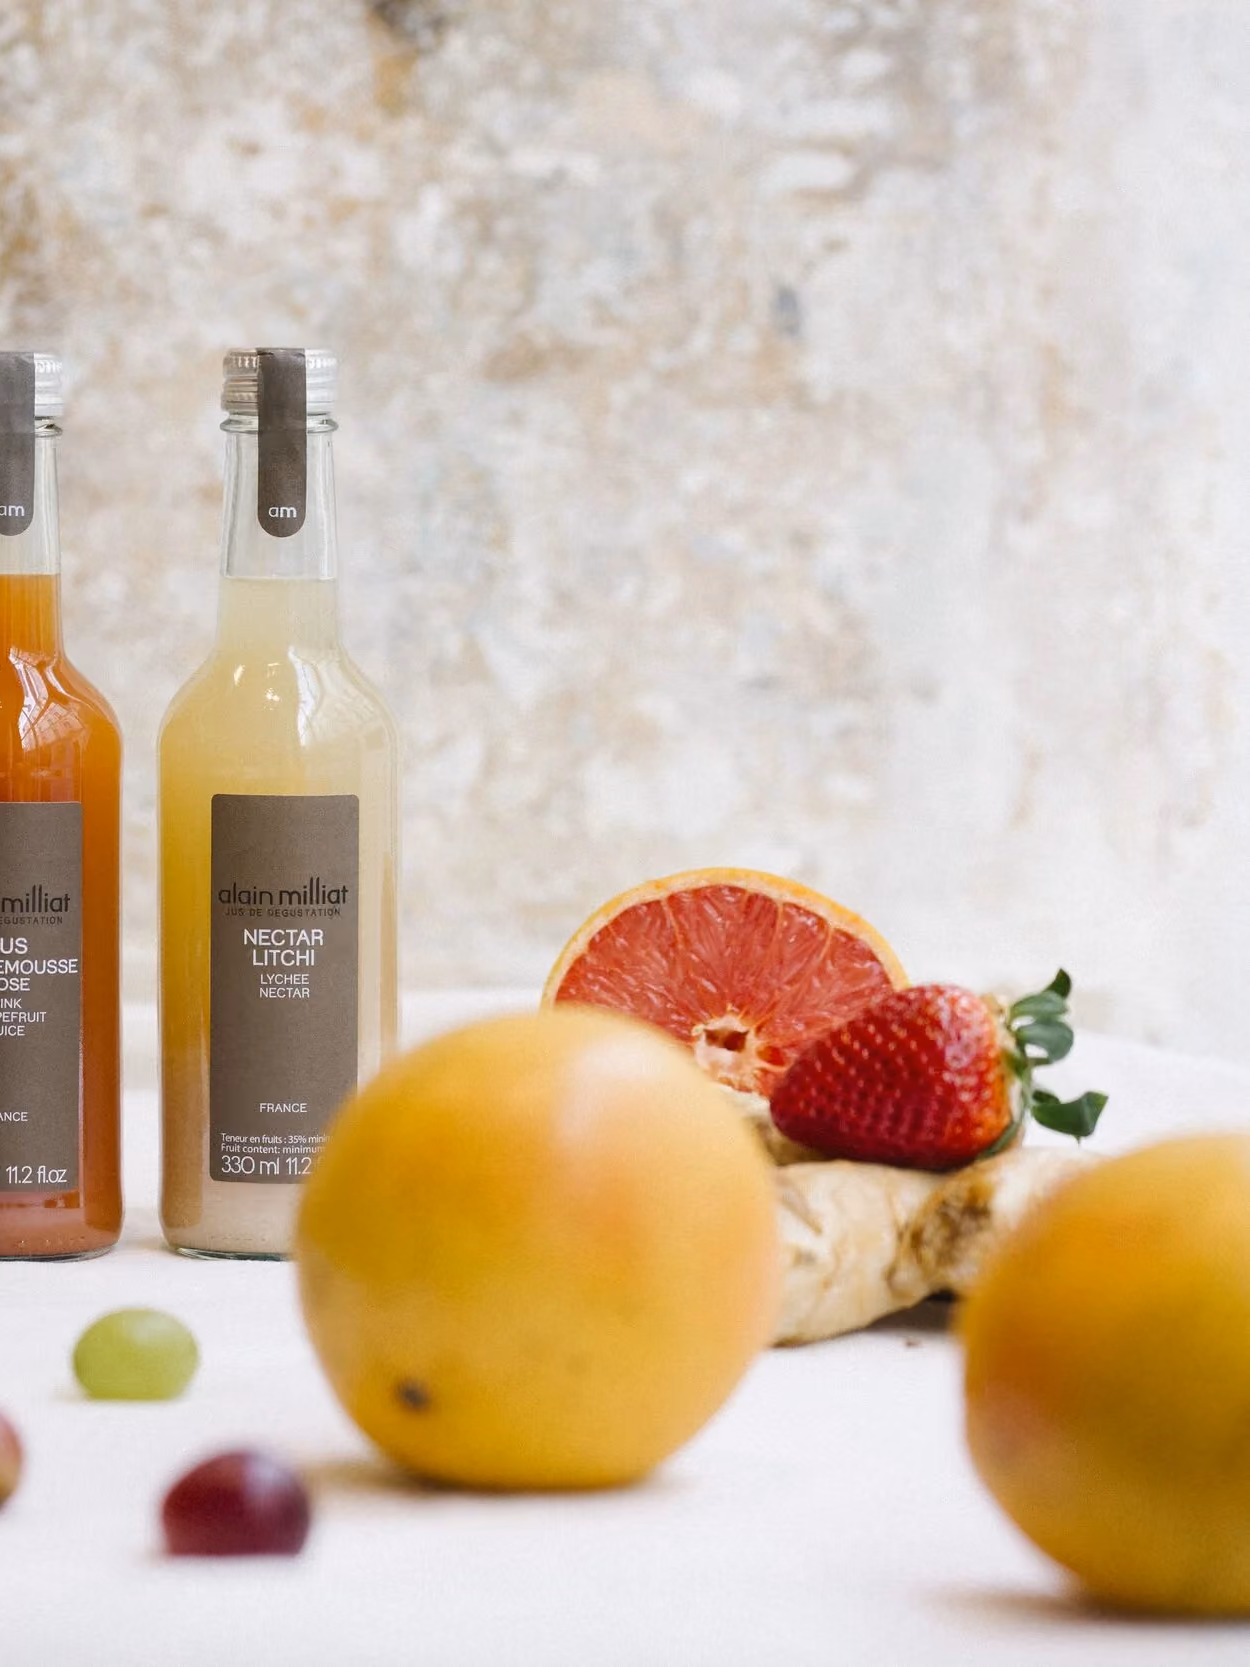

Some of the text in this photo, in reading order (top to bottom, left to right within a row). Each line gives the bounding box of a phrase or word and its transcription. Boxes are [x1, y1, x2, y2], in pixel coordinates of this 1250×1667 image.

[268, 506, 297, 518] am
[218, 877, 349, 905] alain milliat
[1, 884, 71, 913] milliat
[225, 907, 341, 918] JUS DE DEGUSTATION
[243, 928, 324, 946] NECTAR
[252, 949, 315, 966] LITCHI
[260, 973, 310, 985] LYCHEE
[259, 987, 310, 998] NECTAR
[259, 1103, 308, 1113] FRANCE
[221, 1132, 248, 1143] Teneur
[288, 1135, 307, 1144] 35%
[221, 1143, 240, 1153] Fruit
[242, 1145, 281, 1154] content:
[221, 1155, 255, 1174] 330
[259, 1157, 280, 1175] ml
[285, 1156, 312, 1175] 11.2
[5, 1165, 33, 1184] 11.2
[37, 1165, 67, 1184] fl.oz
